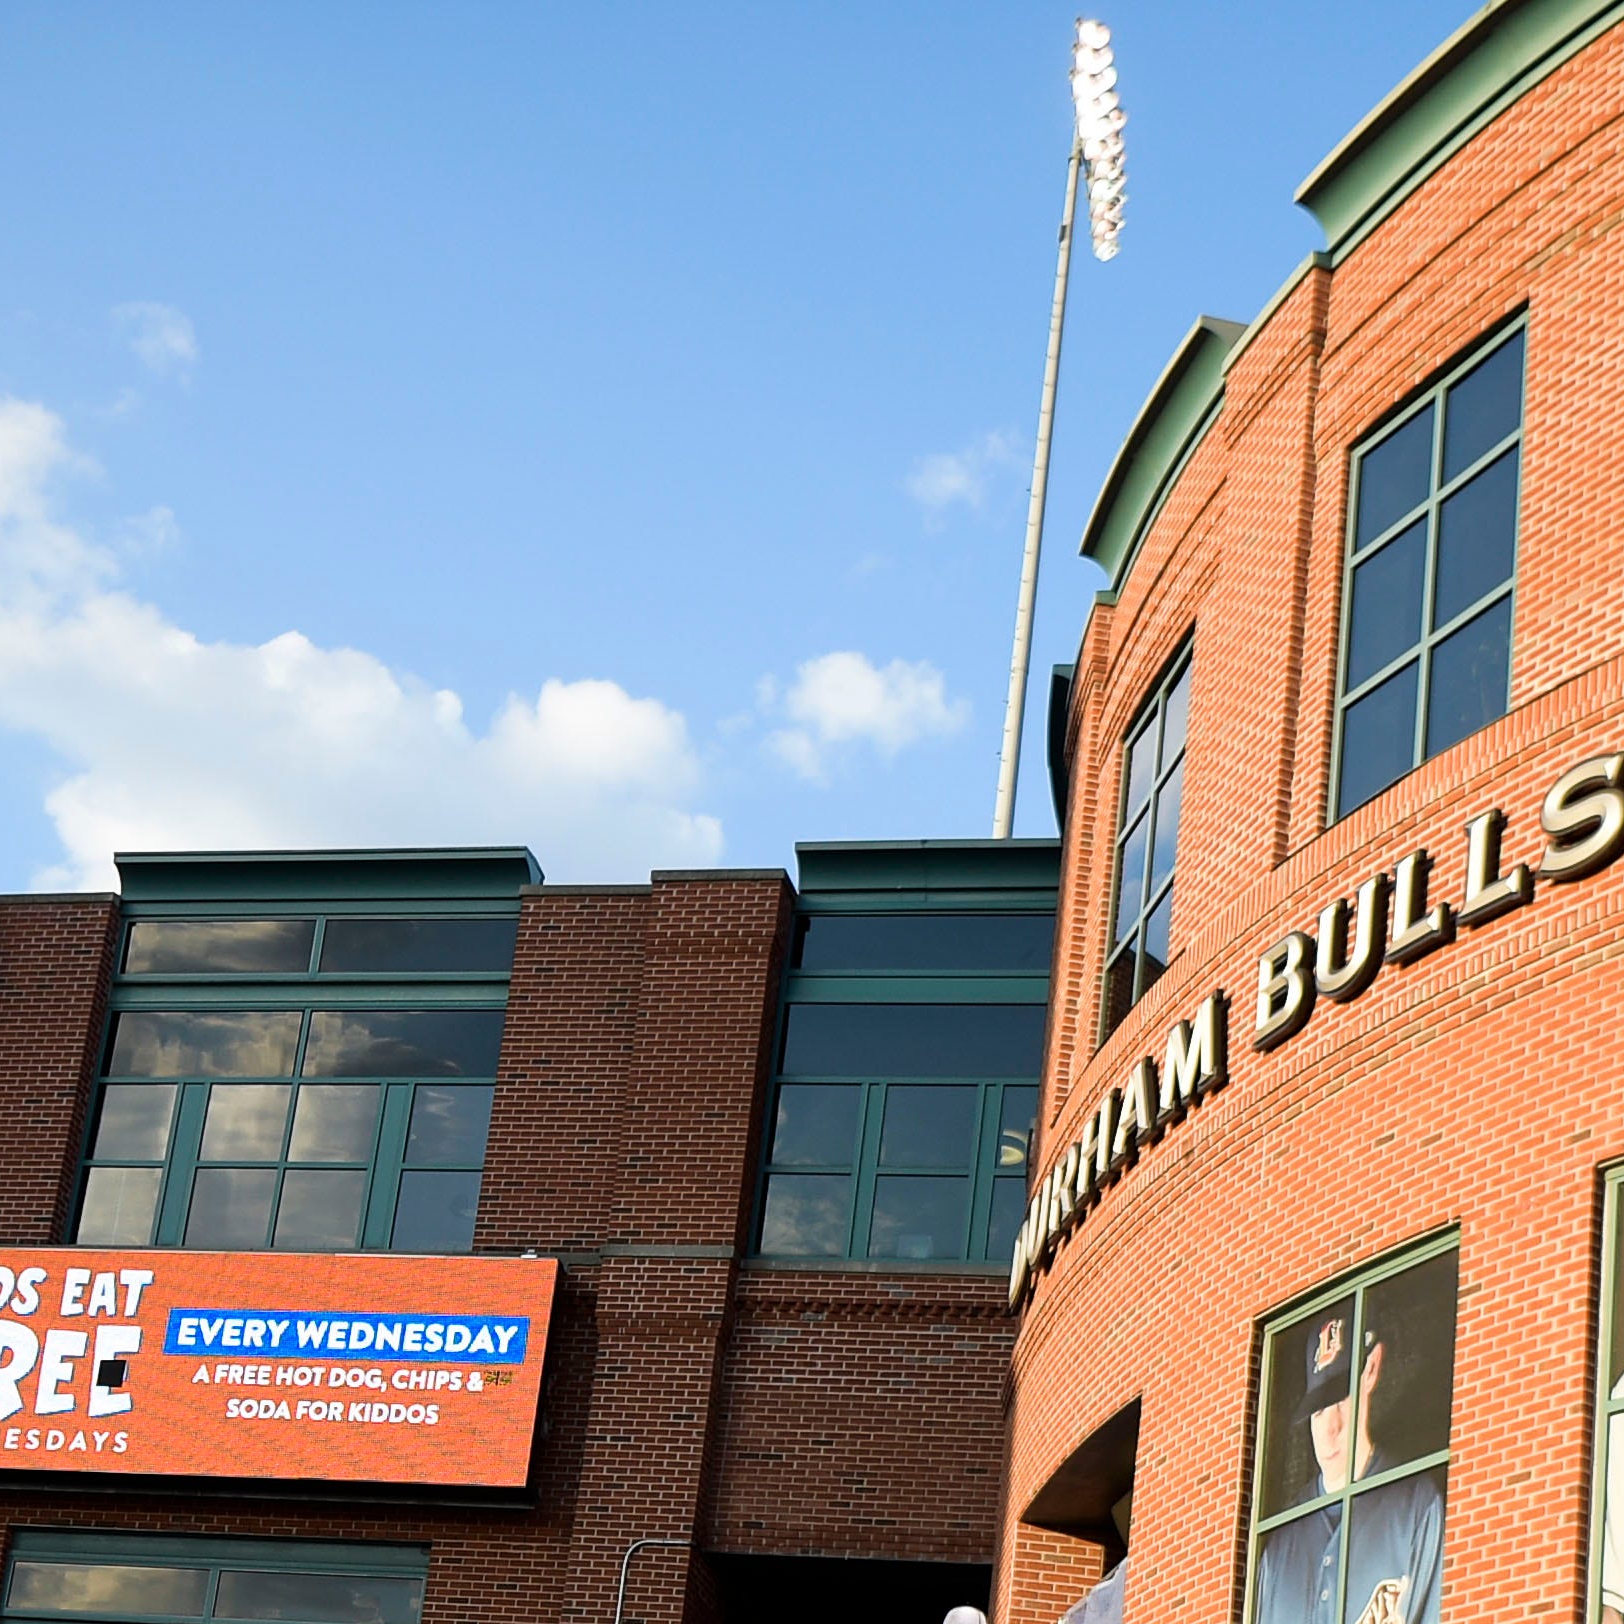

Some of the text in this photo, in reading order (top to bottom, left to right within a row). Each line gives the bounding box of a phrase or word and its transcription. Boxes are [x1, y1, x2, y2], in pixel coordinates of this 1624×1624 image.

[1008, 990, 1229, 1310] DURHAM
[60, 1268, 155, 1318] EAT
[177, 1317, 519, 1353] EVERY WEDNESDAY
[192, 1364, 483, 1393] A FREE HOT DOG, CHIPS &
[225, 1398, 440, 1425] SODA FOR KIDDOS
